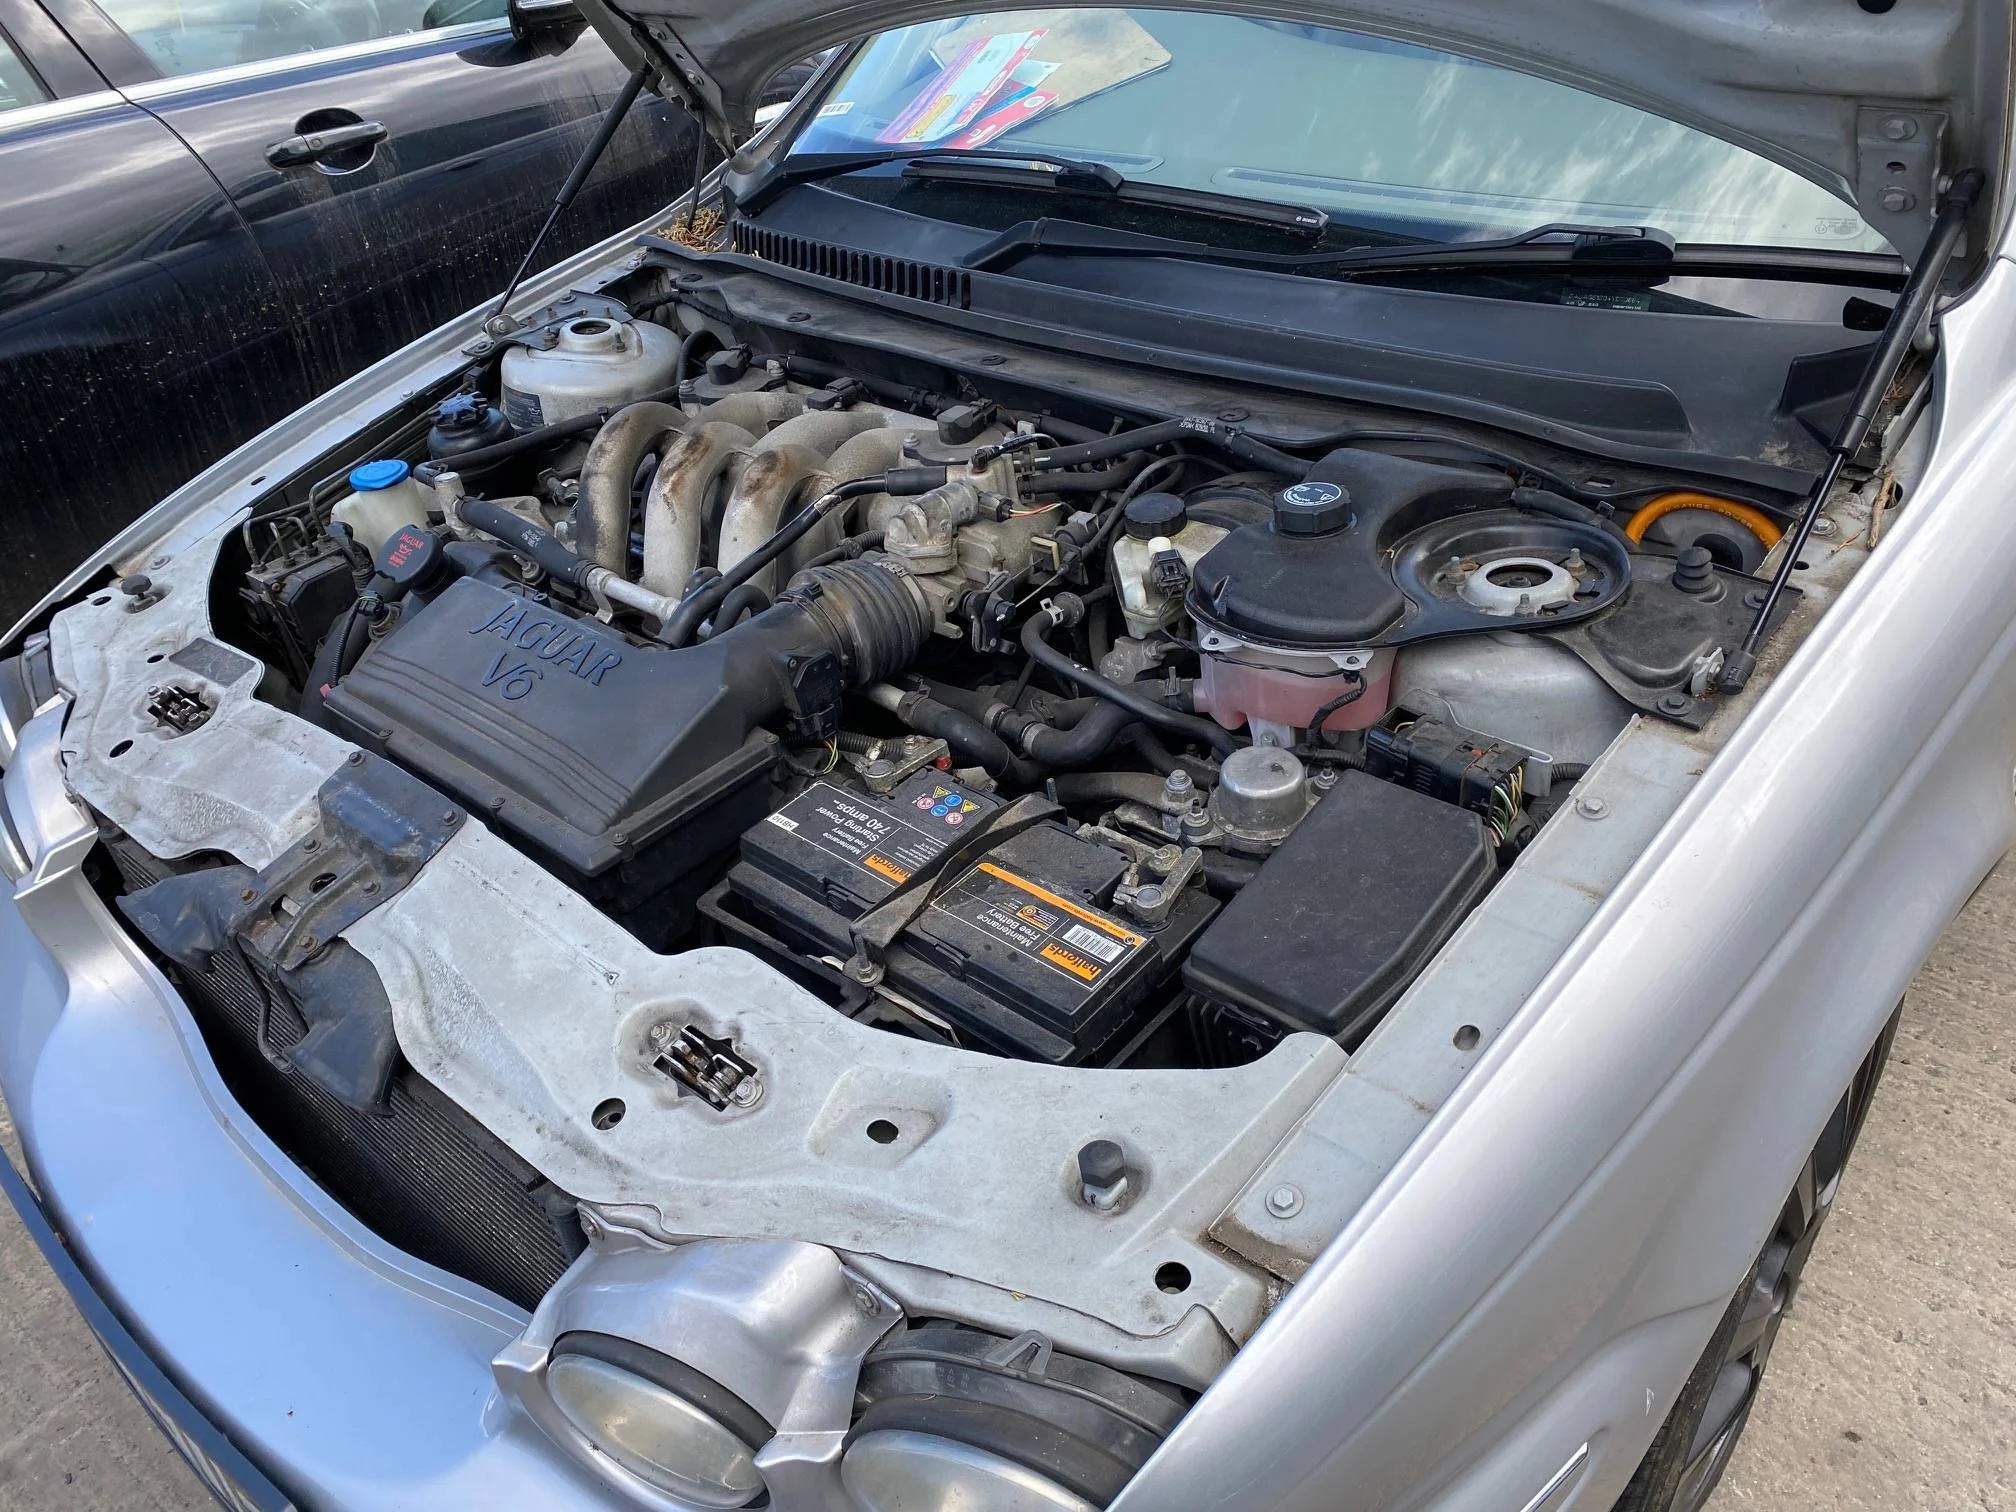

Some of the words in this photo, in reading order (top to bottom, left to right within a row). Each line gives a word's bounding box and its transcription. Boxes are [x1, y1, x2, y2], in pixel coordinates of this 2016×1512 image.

[399, 532, 424, 549] JAGUAR
[468, 600, 623, 687] JAGUAR
[481, 652, 543, 701] V6
[815, 806, 844, 824] Power
[836, 802, 869, 822] amps
[832, 827, 853, 842] Battery
[844, 821, 880, 843] Starting
[867, 819, 891, 835] 740
[822, 832, 862, 855] Maintenance
[853, 838, 869, 850] Free
[986, 908, 1022, 930] Battery
[976, 914, 1034, 947] Maintenance
[1020, 924, 1041, 940] Free
[1049, 943, 1103, 976] halfords
